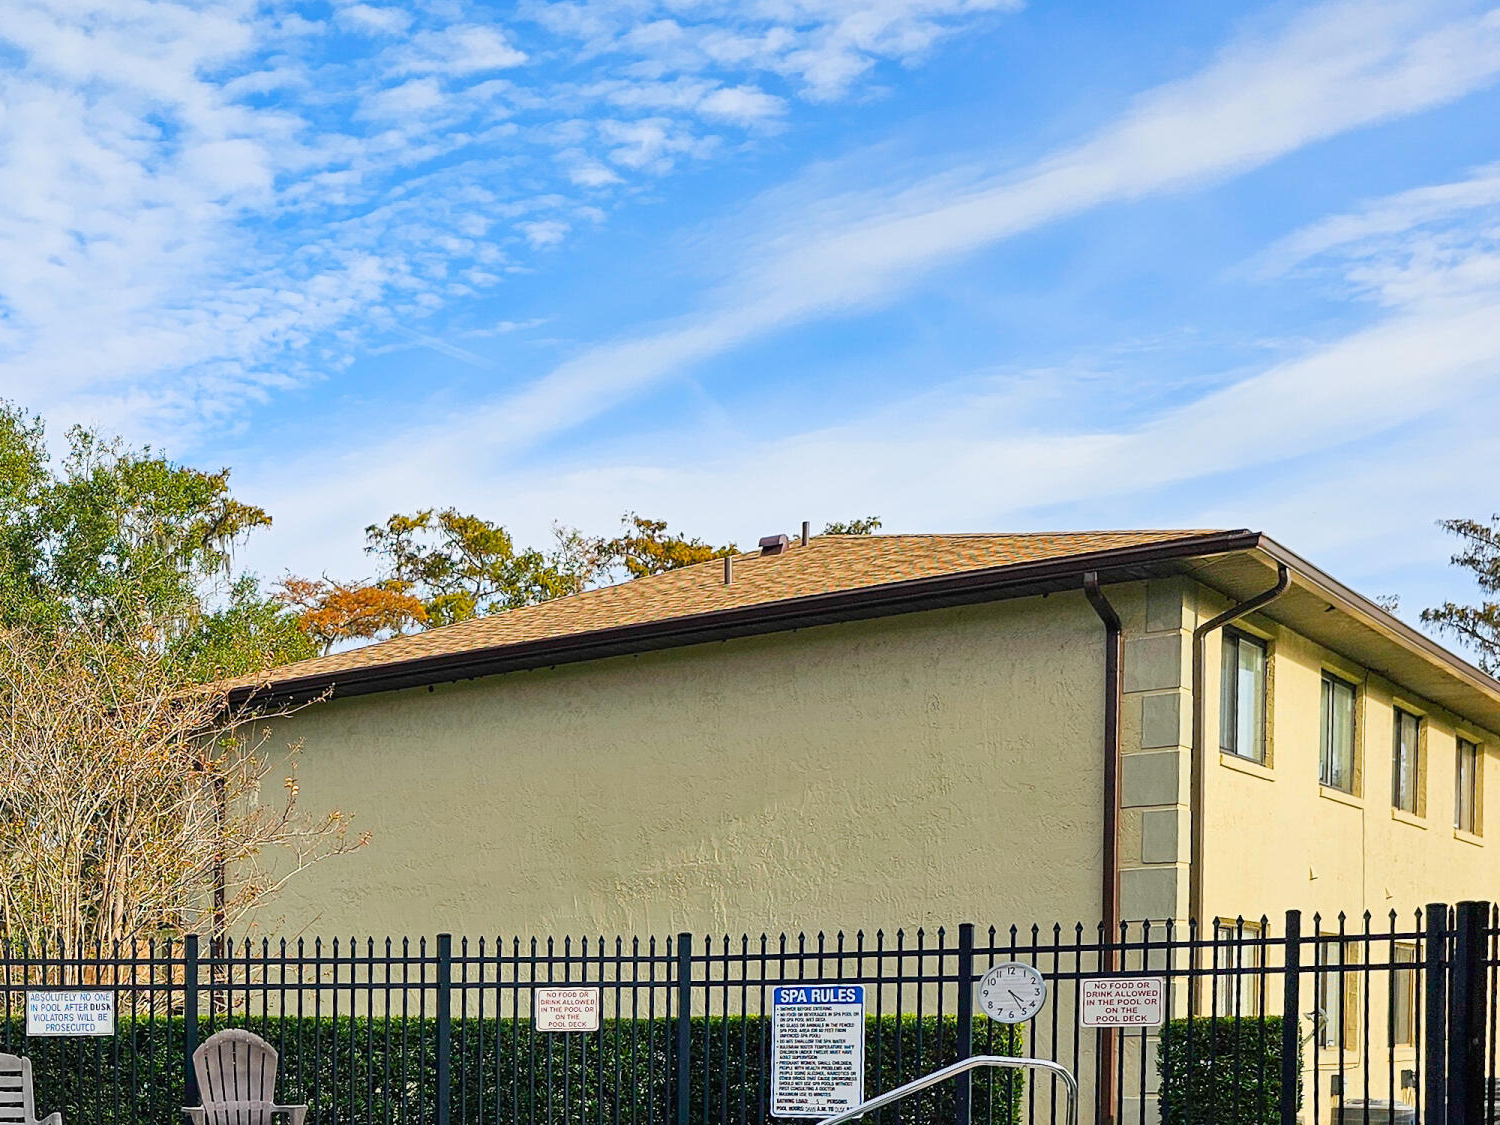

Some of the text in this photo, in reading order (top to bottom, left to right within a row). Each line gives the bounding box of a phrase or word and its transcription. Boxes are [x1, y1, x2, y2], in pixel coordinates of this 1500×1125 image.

[1007, 966, 1015, 975] 12
[1023, 970, 1026, 978] 1
[987, 978, 996, 986] 10
[1030, 977, 1036, 985] 2
[781, 988, 856, 1003] SPA RULES
[983, 990, 989, 998] 9
[1034, 988, 1040, 996] 3
[31, 993, 110, 1002] ABSOLUTELY NO ONE
[31, 1003, 111, 1011] IN POOL AFTER DUSK
[987, 1001, 993, 1009] 8
[1029, 1000, 1036, 1008] 4
[997, 1008, 1003, 1016] 7
[1021, 1007, 1027, 1015] 5
